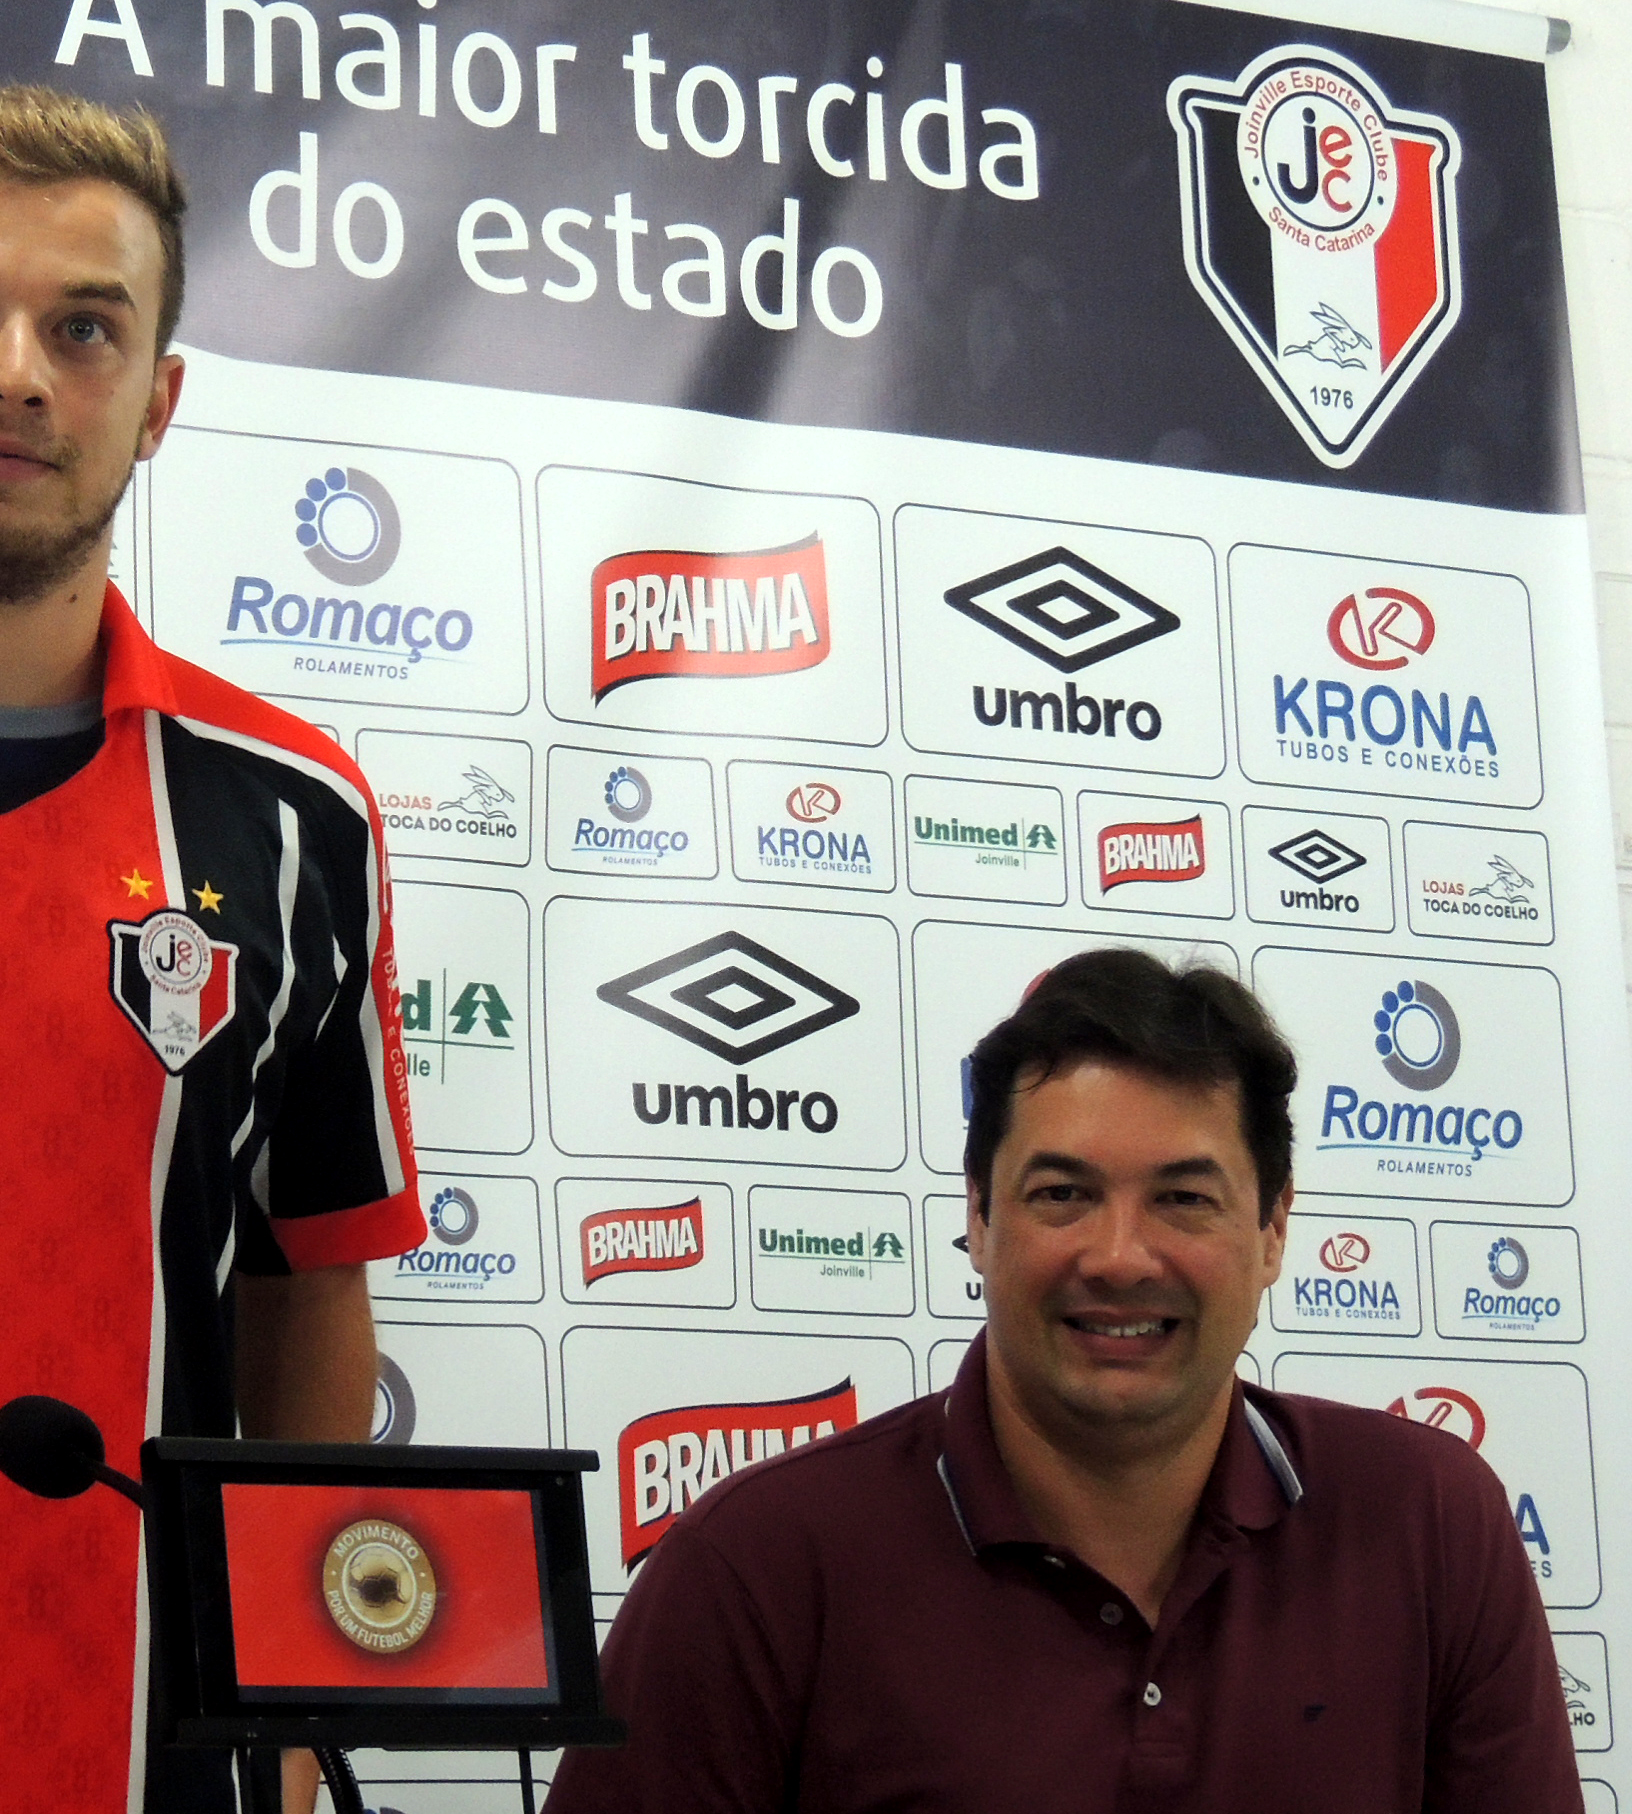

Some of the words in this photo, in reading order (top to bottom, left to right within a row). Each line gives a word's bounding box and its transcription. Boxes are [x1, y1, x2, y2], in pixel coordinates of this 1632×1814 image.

[54, 0, 154, 77] A
[207, 0, 577, 135] maior
[622, 33, 1039, 200] torcida
[1244, 78, 1287, 158] Joinville
[1291, 71, 1361, 111] Esporte
[1363, 114, 1387, 181] Clube
[249, 131, 404, 279] do
[458, 192, 883, 338] estado
[1269, 206, 1311, 246] Santa
[1315, 222, 1376, 252] Catarina
[1310, 386, 1354, 409] 1976
[226, 576, 472, 663] Romaço
[605, 572, 819, 661] BRAHMA
[294, 657, 408, 680] ROLAMENTOS
[973, 683, 1162, 742] umbro
[1273, 674, 1498, 755] KRONA
[1276, 738, 1349, 764] TUBOS
[1362, 747, 1372, 764] E
[1385, 752, 1500, 778] CONEXÕES
[379, 793, 432, 810] LOJAS
[380, 814, 426, 830] TOCA
[429, 817, 452, 832] DO
[456, 818, 517, 838] COELHO
[575, 818, 688, 857] Romaço
[914, 816, 1018, 847] Unimed
[757, 825, 871, 864] KRONA
[975, 854, 1020, 868] Joinville
[1104, 832, 1200, 873] BRAHMA
[758, 856, 796, 868] TUBOS
[802, 860, 809, 869] E
[814, 859, 872, 874] CONEXÕES
[1280, 889, 1359, 915] umbro
[1423, 879, 1465, 896] LOJAS
[1424, 898, 1459, 915] TOCA
[1462, 901, 1481, 917] DO
[1484, 903, 1539, 922] COELHO
[633, 1075, 838, 1134] umbro
[1321, 1084, 1523, 1161] Romaço
[1377, 1159, 1473, 1177] ROLAMENTOS
[588, 1218, 697, 1267] BRAHMA
[759, 1228, 863, 1256] Unimed
[819, 1264, 864, 1278] Joinville
[1294, 1277, 1399, 1309] KRONA
[1464, 1288, 1560, 1322] Romaço
[1296, 1307, 1329, 1317] TUBOS
[1335, 1309, 1341, 1318] E
[1346, 1308, 1400, 1320] CONEXÕES
[334, 1526, 418, 1559] MOVIMENTO
[328, 1590, 346, 1617] POR
[340, 1615, 358, 1635] UM
[357, 1628, 409, 1648] FUTEBOL
[405, 1592, 433, 1638] MELHOR
